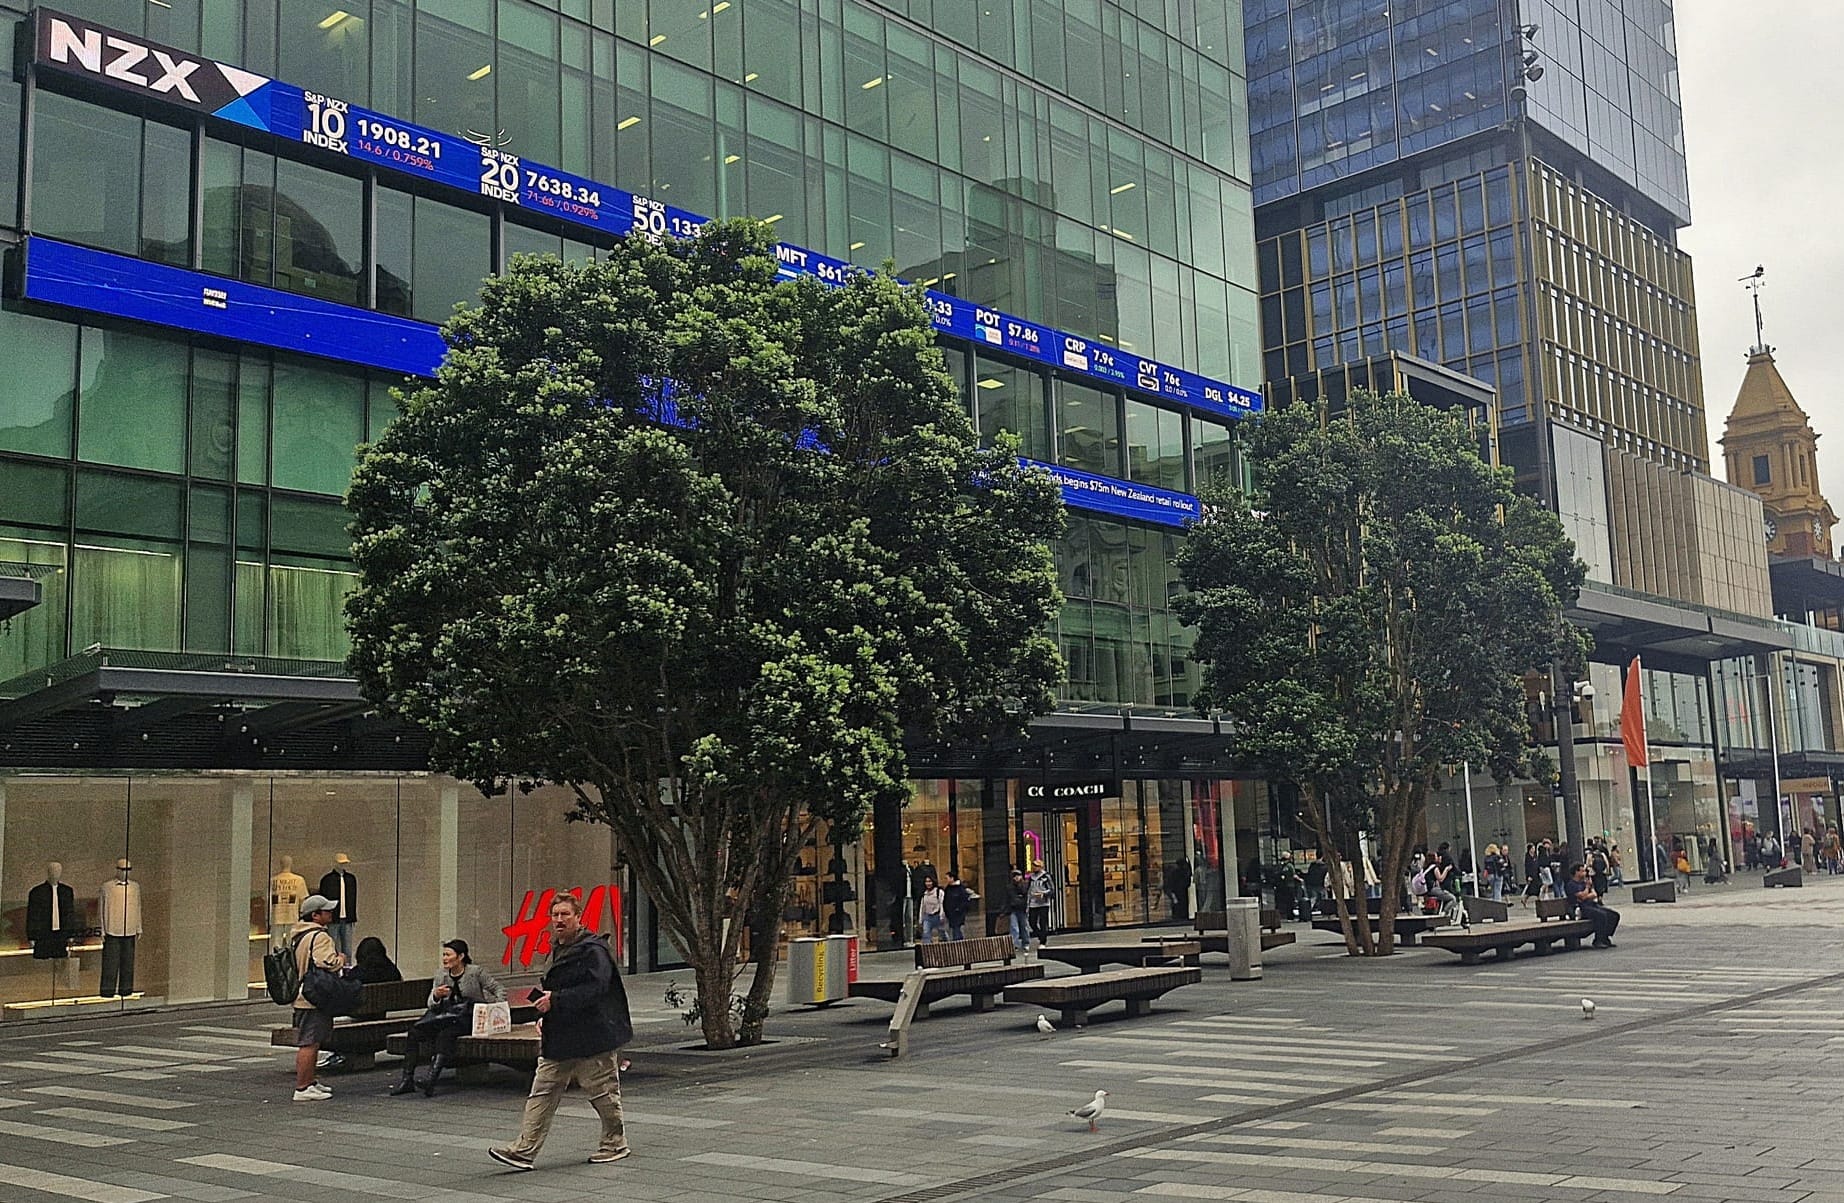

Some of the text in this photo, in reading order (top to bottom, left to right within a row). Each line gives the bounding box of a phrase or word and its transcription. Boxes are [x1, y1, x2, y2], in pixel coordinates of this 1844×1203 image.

[50, 18, 201, 104] NZX
[307, 103, 345, 139] 10
[303, 129, 349, 155] INDEX
[357, 119, 441, 159] 1908.21
[358, 139, 383, 155] 14.6
[392, 150, 434, 171] 0.759%
[481, 158, 519, 191] 20
[480, 182, 520, 205] INDEX
[526, 170, 601, 207] 7638.34
[633, 205, 666, 236] 50
[672, 218, 702, 239] 133
[776, 245, 808, 267] MFT
[924, 297, 952, 317] 1.33
[975, 308, 1001, 327] POT
[1008, 323, 1038, 343] $7.86
[1065, 337, 1086, 353] CRP
[1139, 361, 1158, 376] CVT
[1205, 387, 1223, 402] DGL
[1228, 391, 1250, 408] $4.25
[1063, 474, 1089, 490] begins
[1090, 479, 1110, 494] $75m
[1111, 485, 1127, 497] New
[1127, 488, 1155, 504] Zealand
[1155, 496, 1172, 507] retail
[1173, 498, 1194, 512] rollout
[1054, 784, 1104, 797] COACH
[501, 884, 623, 967] H&M
[816, 950, 826, 993] Recycling
[849, 948, 857, 972] Litter
